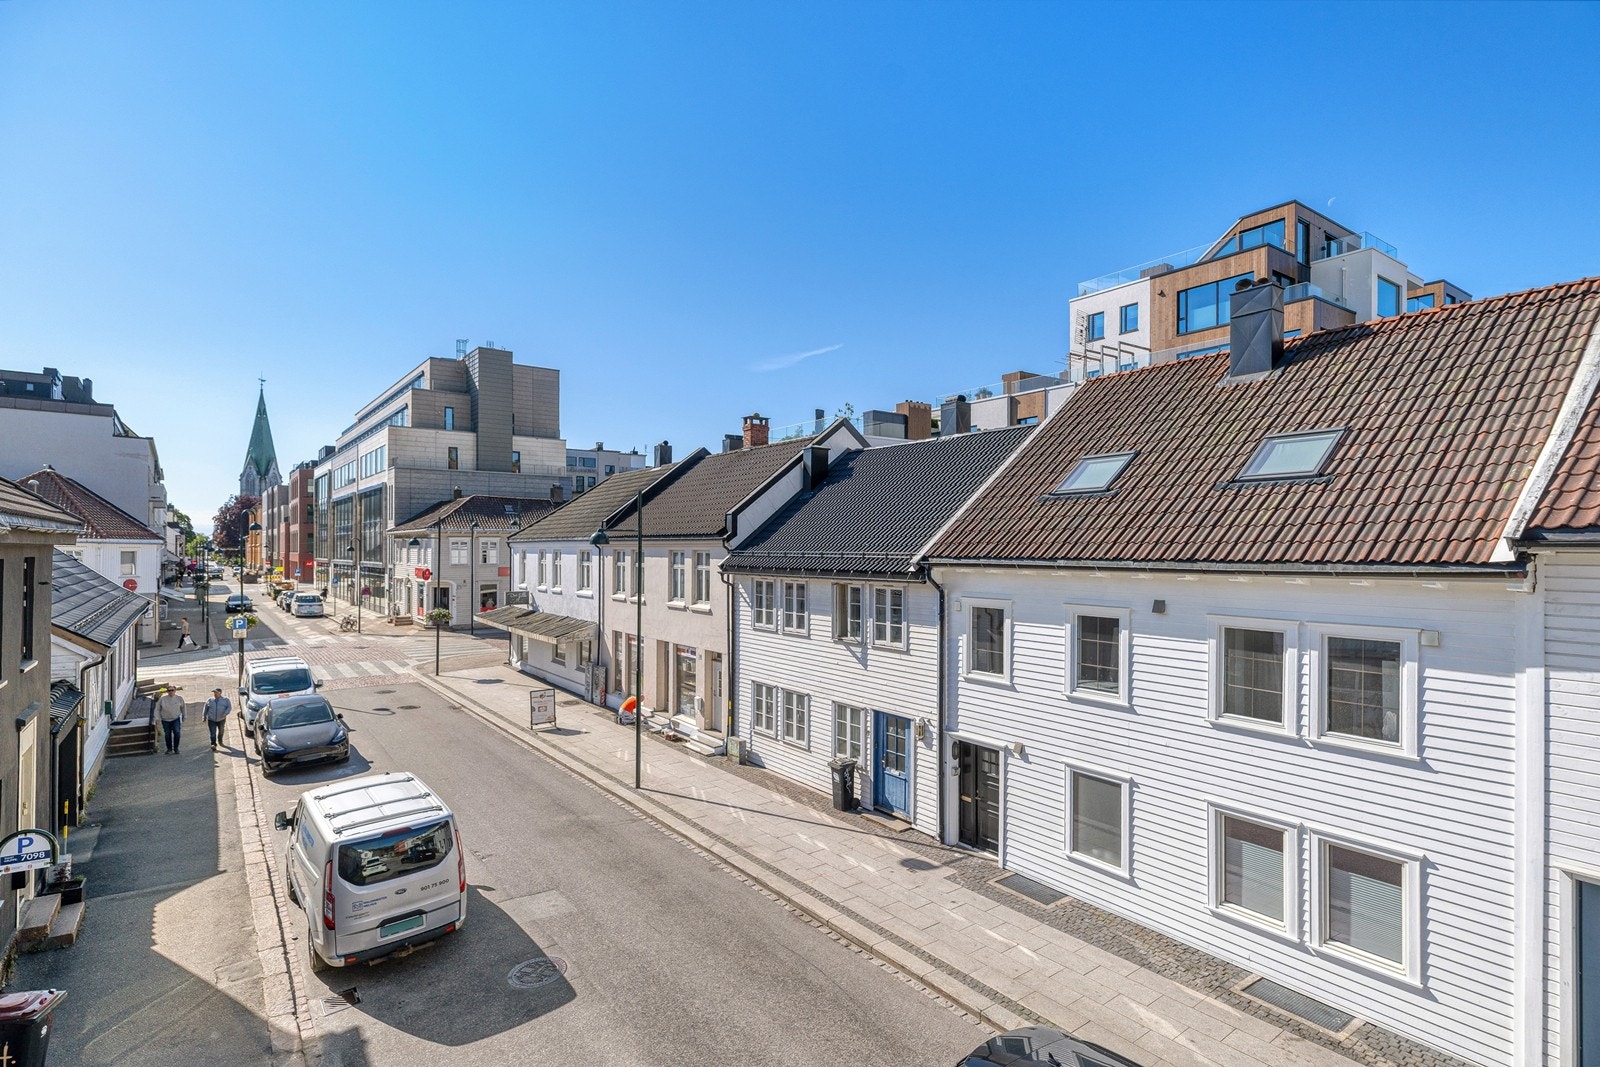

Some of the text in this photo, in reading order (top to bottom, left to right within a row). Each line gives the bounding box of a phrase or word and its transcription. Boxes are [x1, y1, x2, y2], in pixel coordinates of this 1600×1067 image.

[235, 619, 244, 628] P
[17, 837, 34, 854] P
[21, 851, 46, 861] 7098
[439, 878, 450, 886] 900
